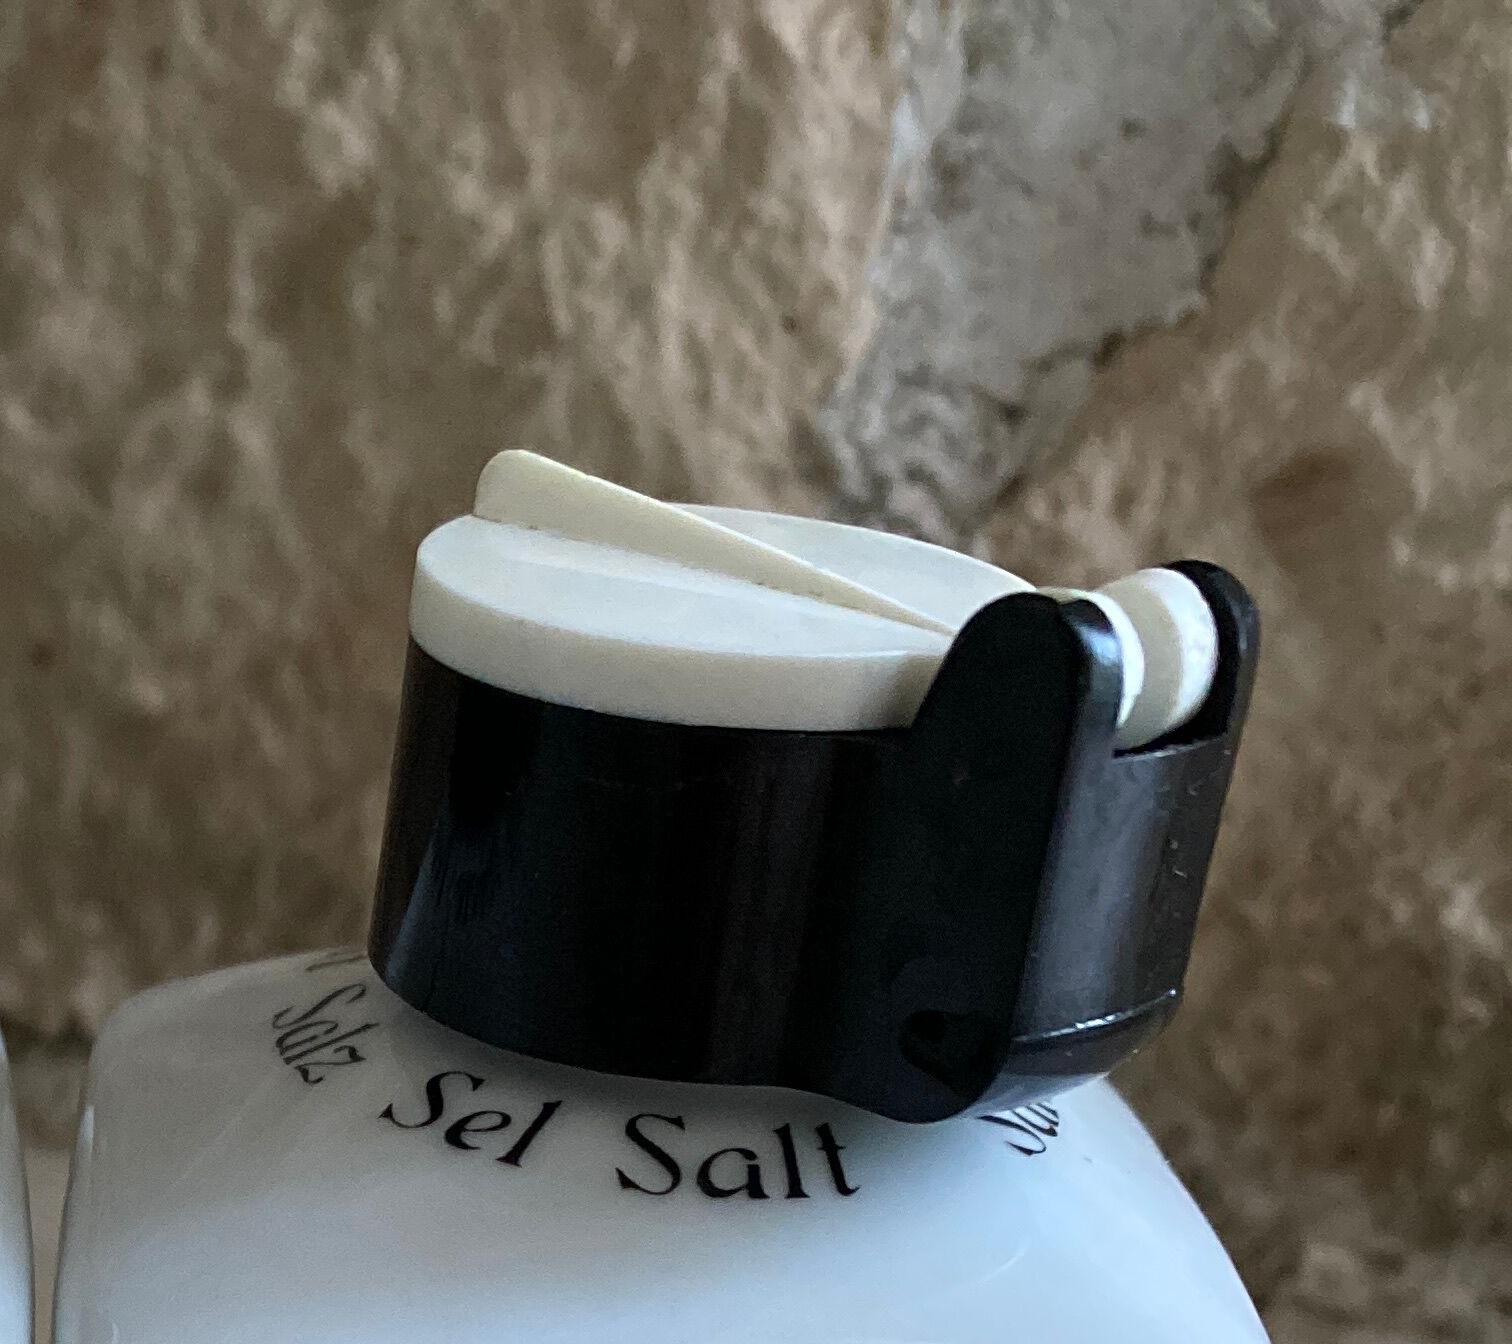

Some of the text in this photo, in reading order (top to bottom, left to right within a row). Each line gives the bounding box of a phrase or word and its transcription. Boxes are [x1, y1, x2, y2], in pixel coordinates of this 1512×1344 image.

[272, 983, 380, 1084] Salz
[378, 1070, 563, 1168] Sel
[615, 1112, 861, 1200] Salt
